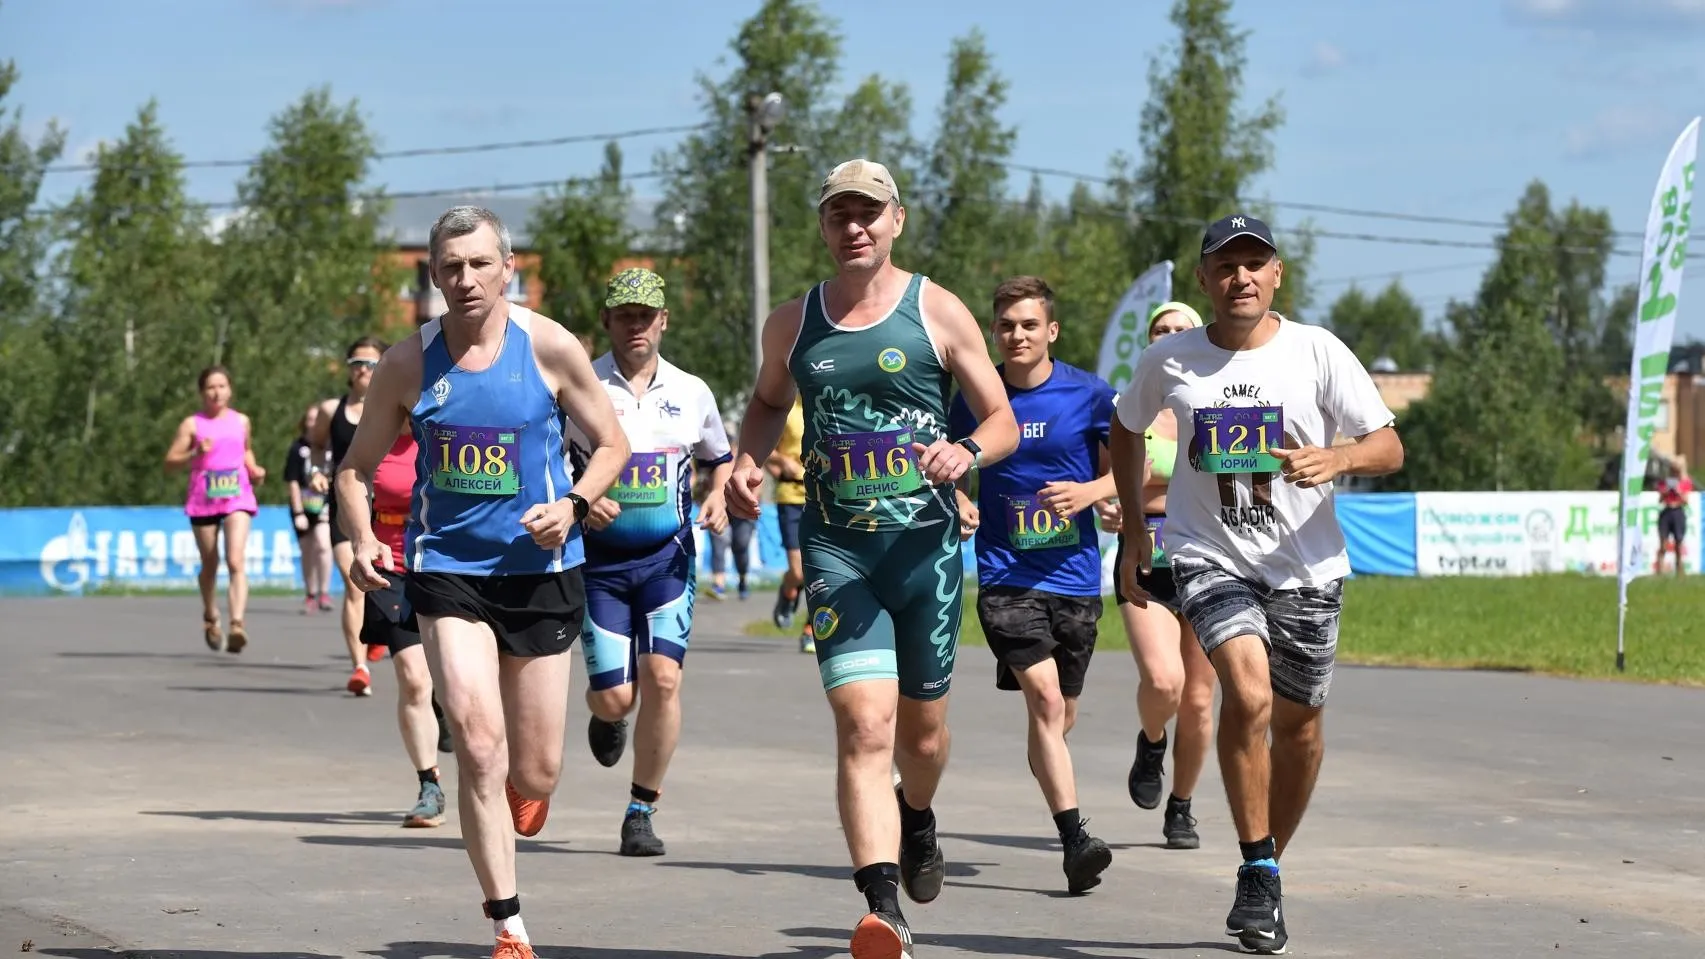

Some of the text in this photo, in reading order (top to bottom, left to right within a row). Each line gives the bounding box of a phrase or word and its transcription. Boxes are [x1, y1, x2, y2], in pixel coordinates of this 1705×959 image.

[1223, 384, 1261, 399] CAMEL
[1023, 422, 1047, 438] БЕГ
[1207, 424, 1270, 456] 121
[439, 443, 507, 476] 108
[840, 447, 909, 481] 116
[1220, 456, 1258, 469] ЮРИЙ
[444, 478, 501, 490] АЛЕКСЕЙ
[855, 481, 900, 497] ДЕНИС
[618, 491, 655, 500] КИРИЛЛ
[1220, 505, 1276, 528] AGADIR
[1015, 534, 1075, 547] АЛЕКСАНДР
